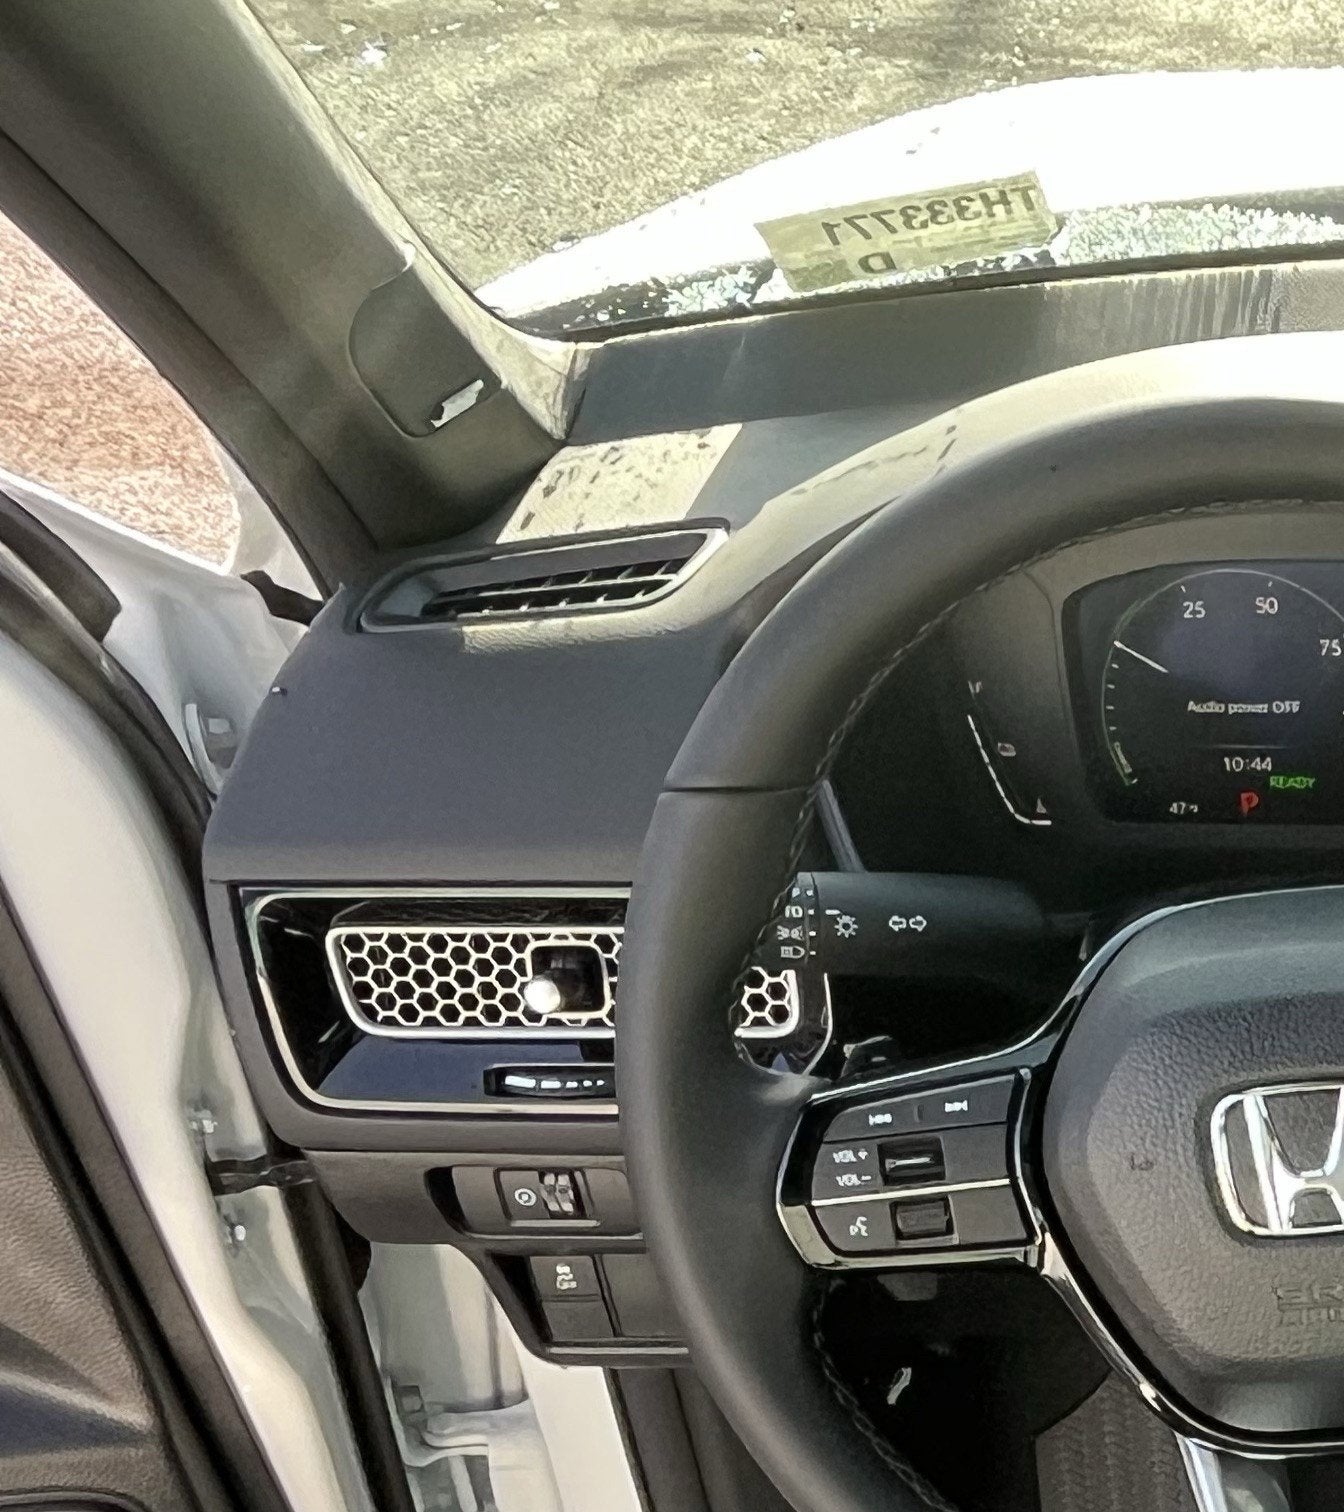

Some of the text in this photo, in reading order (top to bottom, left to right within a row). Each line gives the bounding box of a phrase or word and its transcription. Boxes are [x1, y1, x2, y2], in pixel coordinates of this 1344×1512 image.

[1182, 600, 1206, 619] 25
[1255, 596, 1279, 615] 50
[1319, 638, 1342, 656] 75
[1223, 757, 1272, 772] 10:44
[1239, 792, 1260, 816] P
